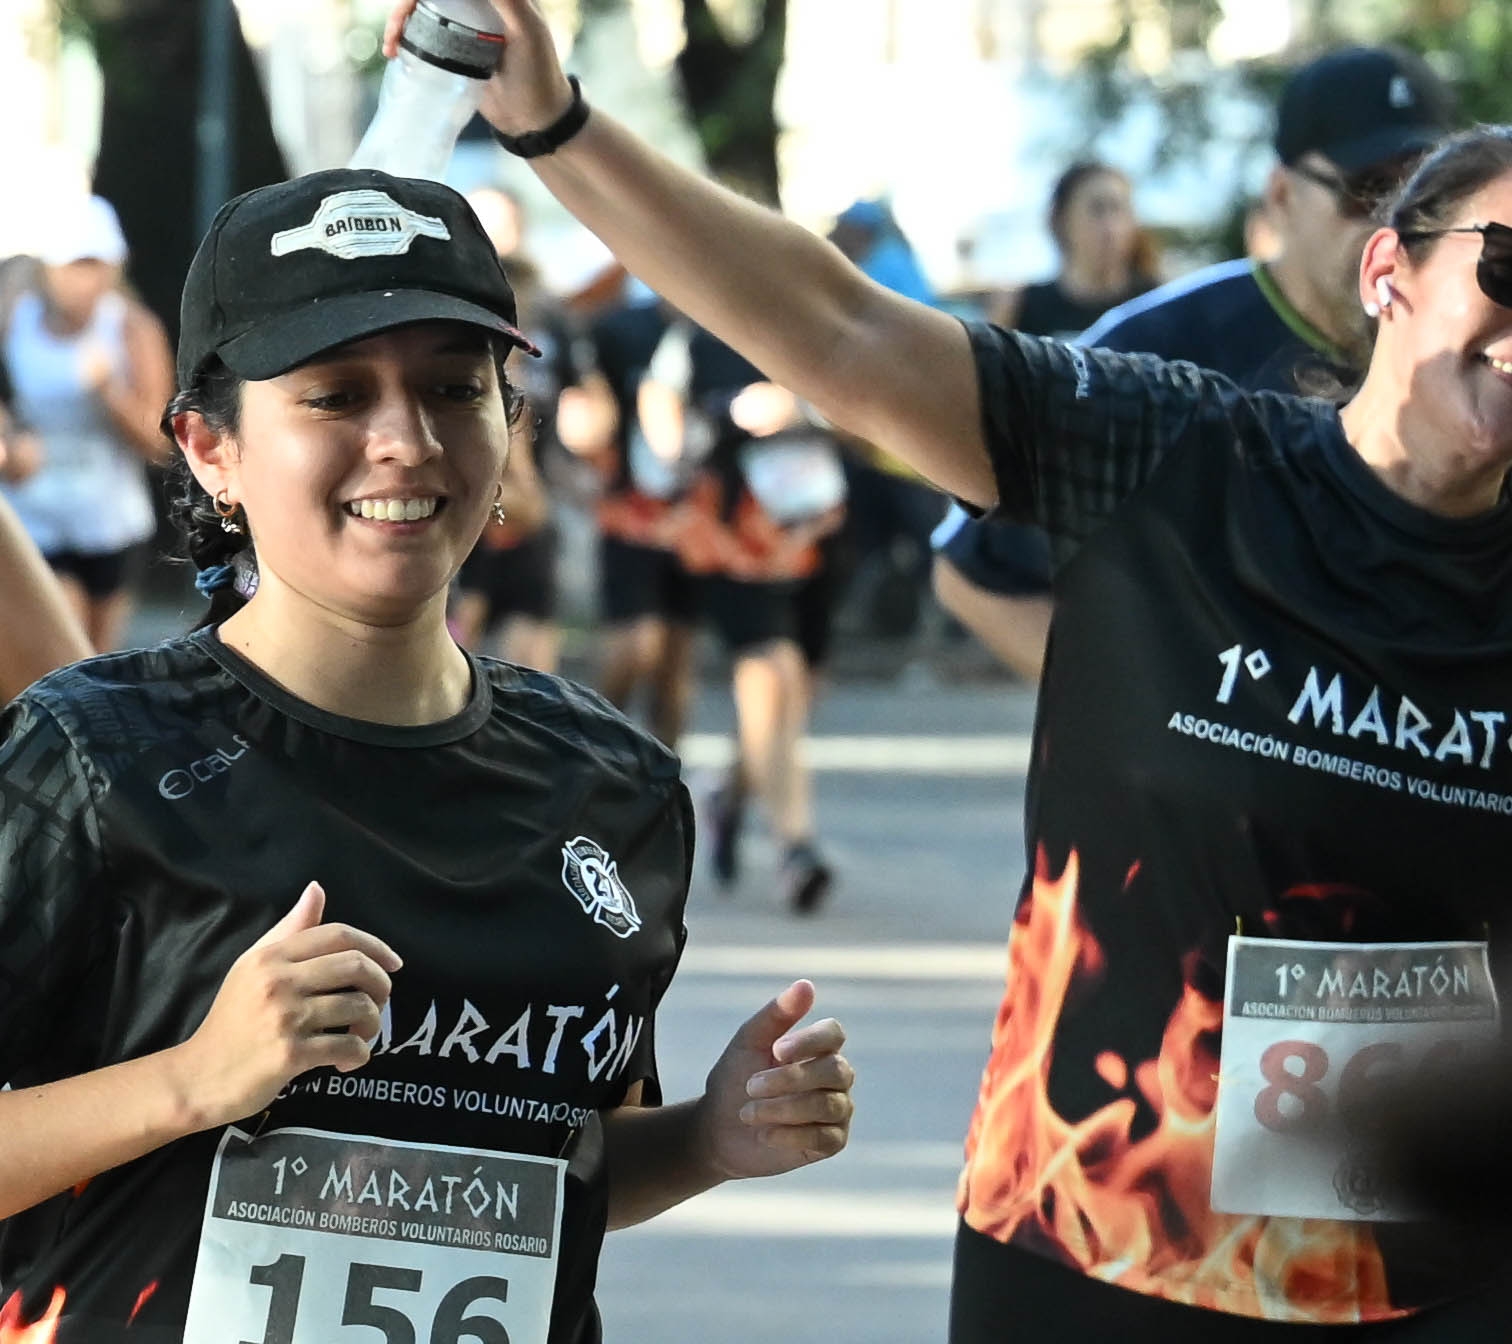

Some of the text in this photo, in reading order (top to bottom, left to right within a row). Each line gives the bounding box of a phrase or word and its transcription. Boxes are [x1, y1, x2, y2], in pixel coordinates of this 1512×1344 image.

[1214, 642, 1512, 770] 1° MARAT
[1166, 711, 1512, 816] ASOCIACIÓN BOMBEROS VOLUNTARIO
[1275, 955, 1471, 999] 1° MARATÓN
[327, 1076, 446, 1108] BOMBEROS
[271, 1154, 519, 1221] 1° MARATÓN
[227, 1200, 548, 1255] ASOCIACIÓN BOMBEROS VOLUNTARIOS ROSARIO
